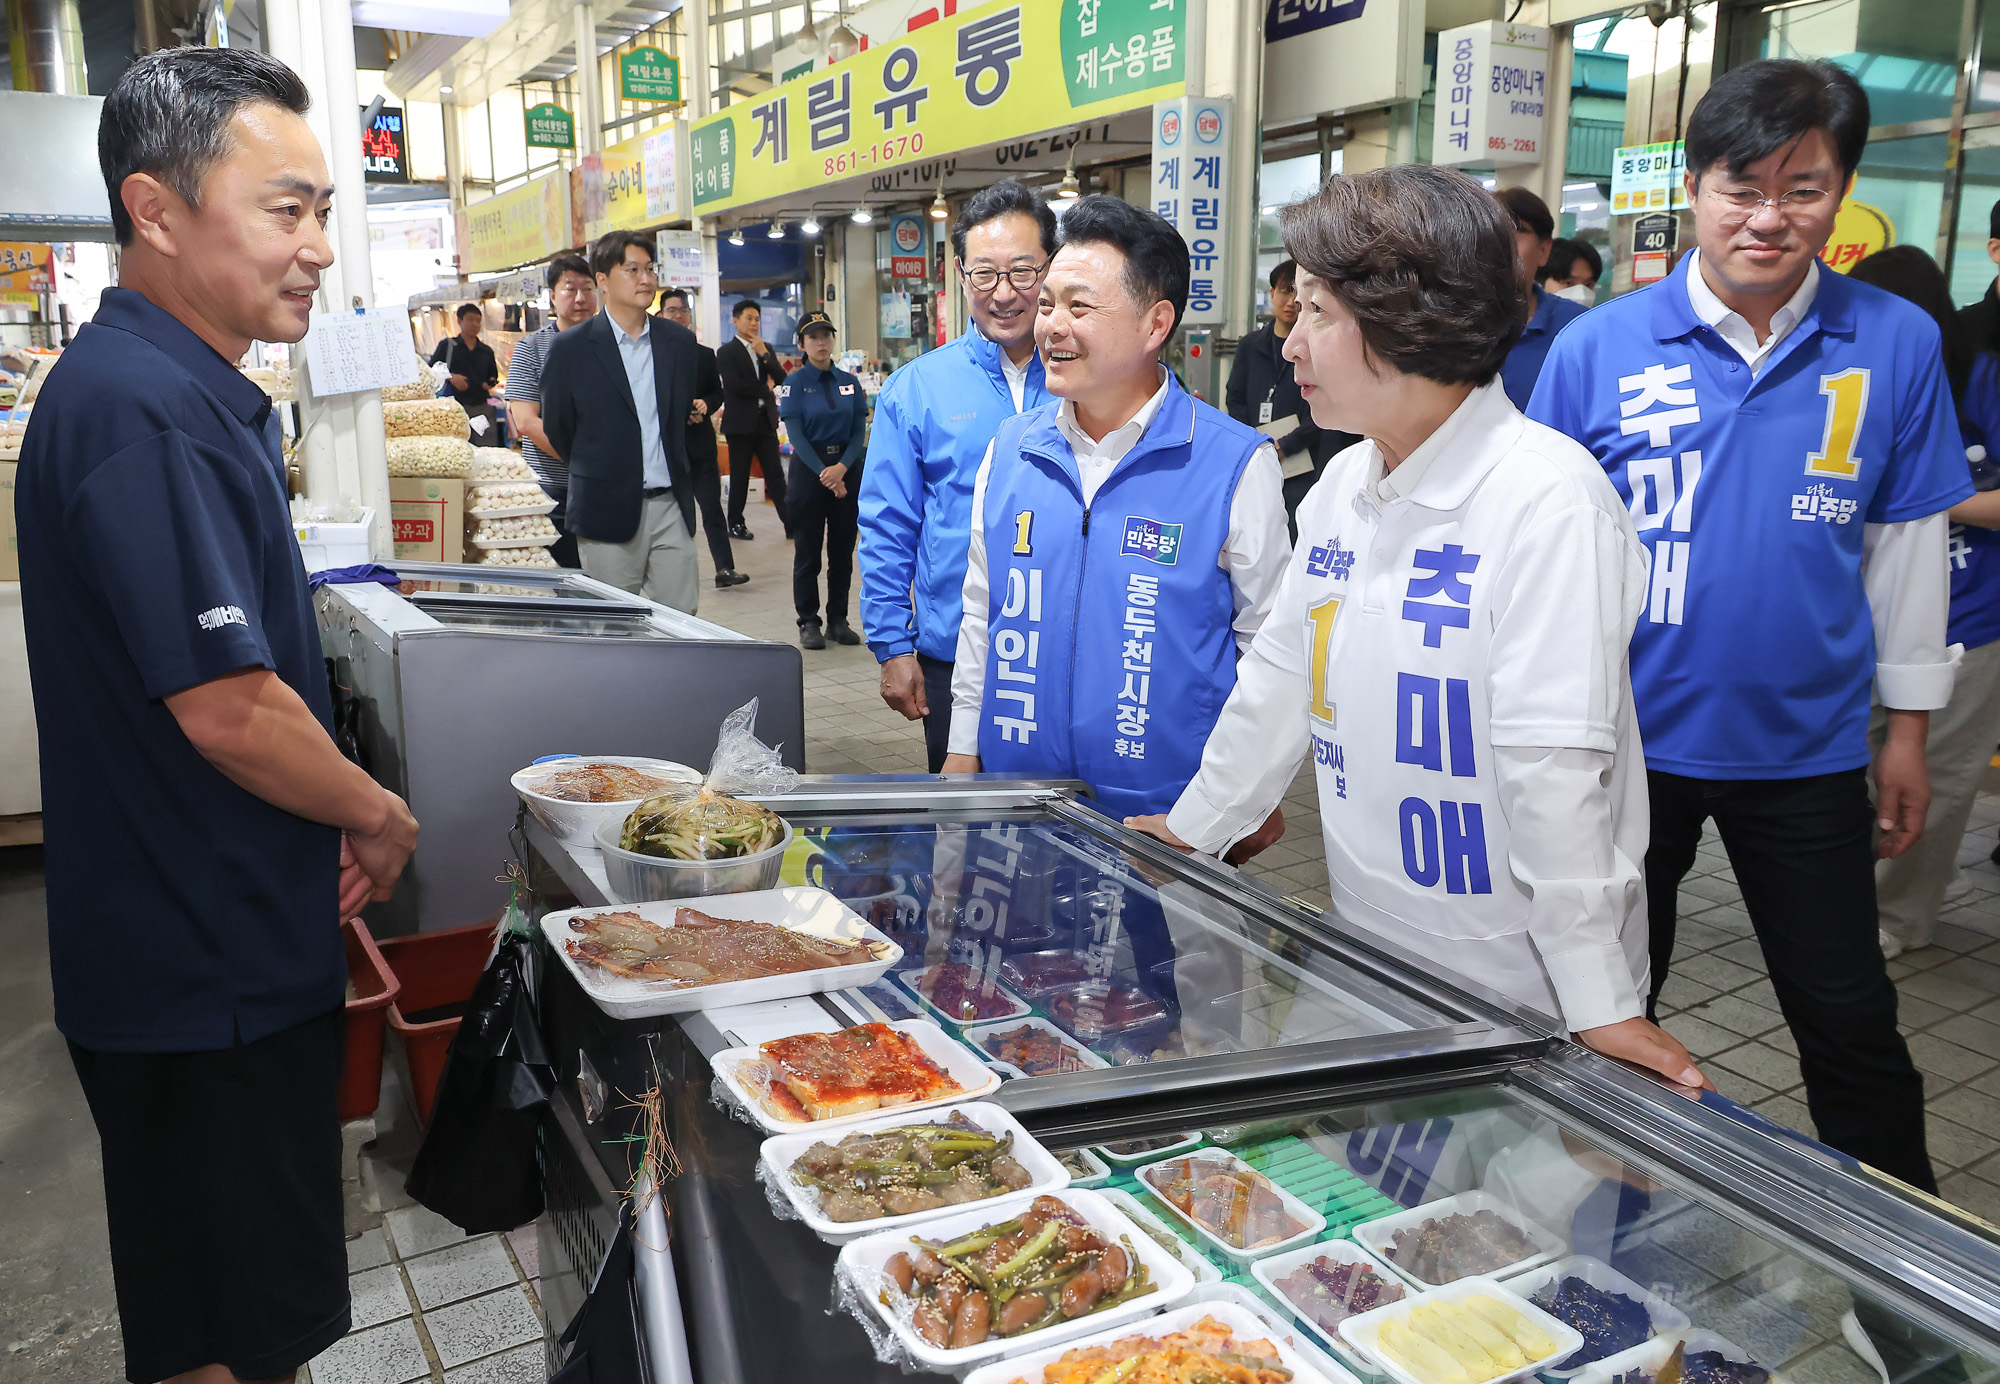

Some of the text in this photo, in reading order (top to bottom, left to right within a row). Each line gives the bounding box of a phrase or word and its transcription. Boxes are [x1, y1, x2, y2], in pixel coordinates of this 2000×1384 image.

[628, 64, 673, 81] 계림유통
[1076, 25, 1176, 89] 제수용품
[751, 8, 1022, 167] 계림유통
[1449, 38, 1474, 151] 중앙마니커
[1491, 65, 1546, 96] 중앙마니커
[824, 132, 924, 177] 861-1670
[1488, 136, 1537, 152] 865-2261
[607, 160, 643, 203] 순아네
[694, 162, 731, 196] 건어물
[1188, 156, 1220, 311] 계림유통
[1645, 232, 1666, 249] 40
[1804, 366, 1871, 481] 1
[1618, 363, 1703, 626] 추미애
[1790, 494, 1858, 525] 민주당
[1805, 483, 1834, 498] 더불어
[1013, 509, 1035, 557] 1
[1126, 530, 1177, 554] 민주당
[1136, 523, 1155, 534] 더불어
[993, 567, 1044, 745] 이인규
[1115, 573, 1159, 737] 동두천시장
[1304, 592, 1357, 731] 1
[1396, 543, 1493, 895] 추미애
[1114, 738, 1145, 760] 후보
